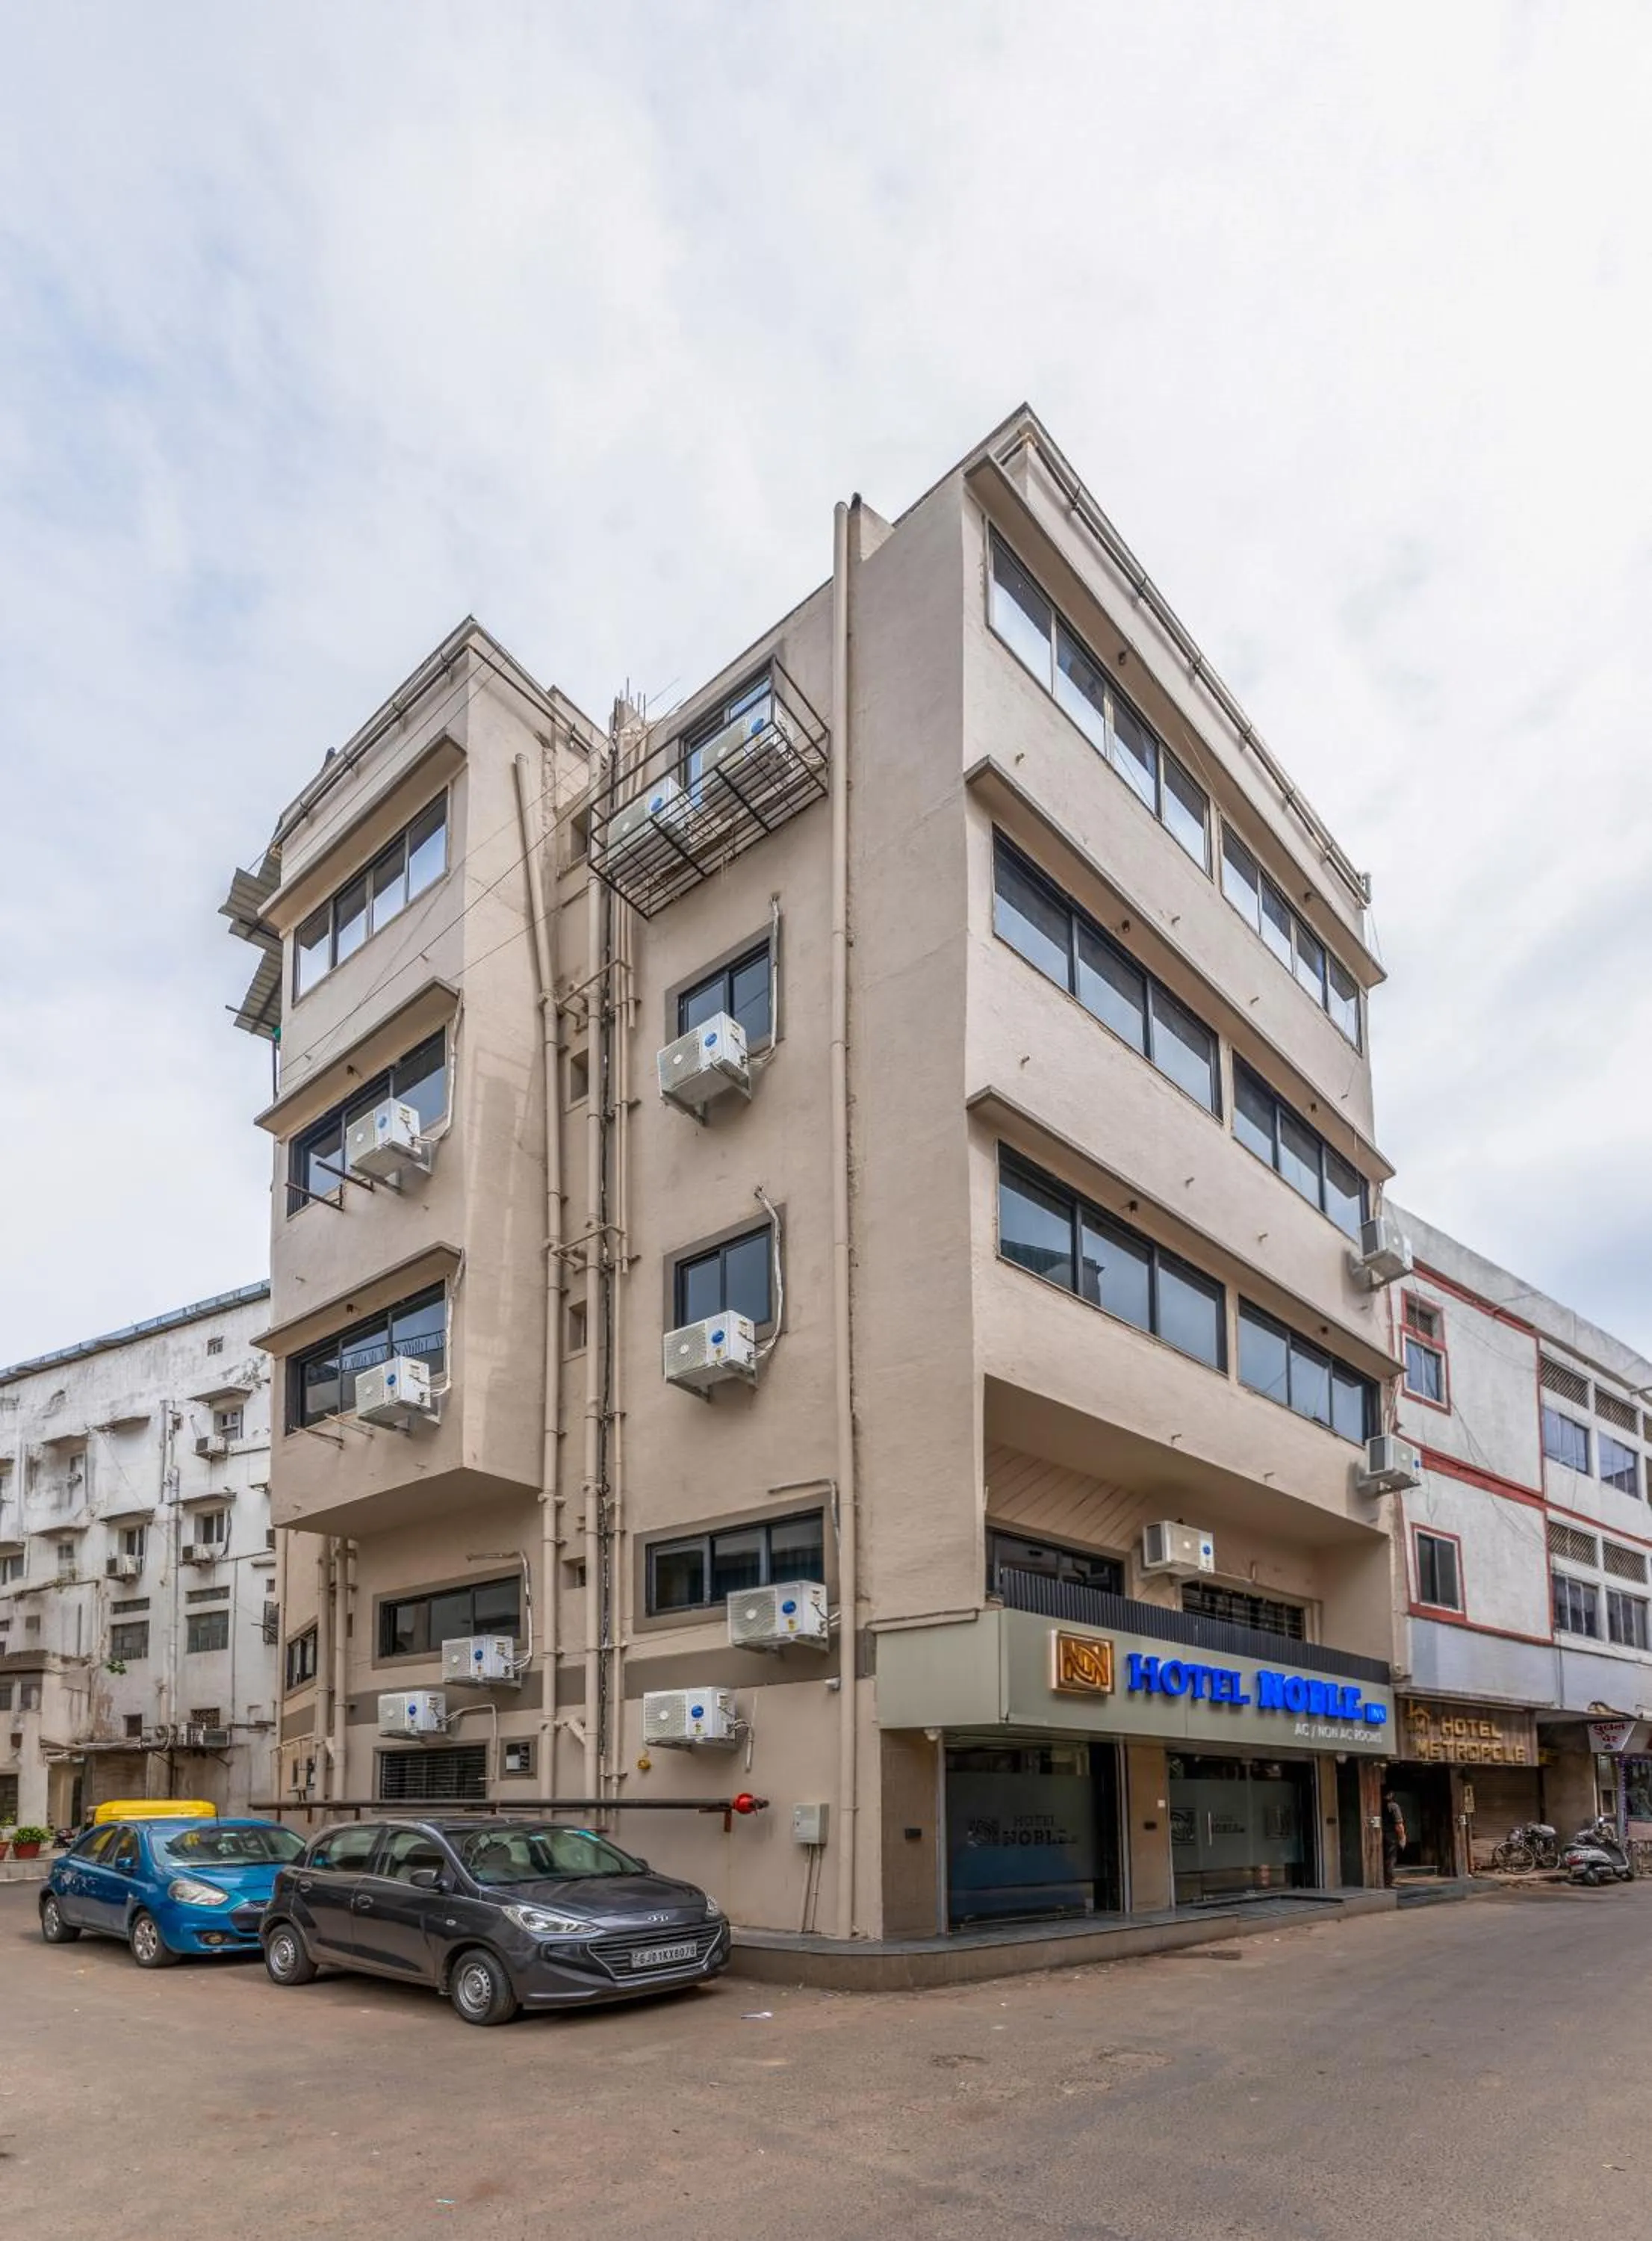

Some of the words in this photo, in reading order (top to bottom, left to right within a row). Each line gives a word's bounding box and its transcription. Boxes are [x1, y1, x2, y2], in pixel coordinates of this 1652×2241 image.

[1127, 1652, 1251, 1705] HOTEL
[1258, 1670, 1362, 1720] NOBLE
[1294, 1723, 1309, 1736] AC
[1317, 1726, 1338, 1739] NON
[1340, 1727, 1353, 1740] AC
[1354, 1729, 1382, 1743] ROOMS
[1441, 1717, 1503, 1741] HOTEL
[1417, 1738, 1526, 1764] METROPOLE
